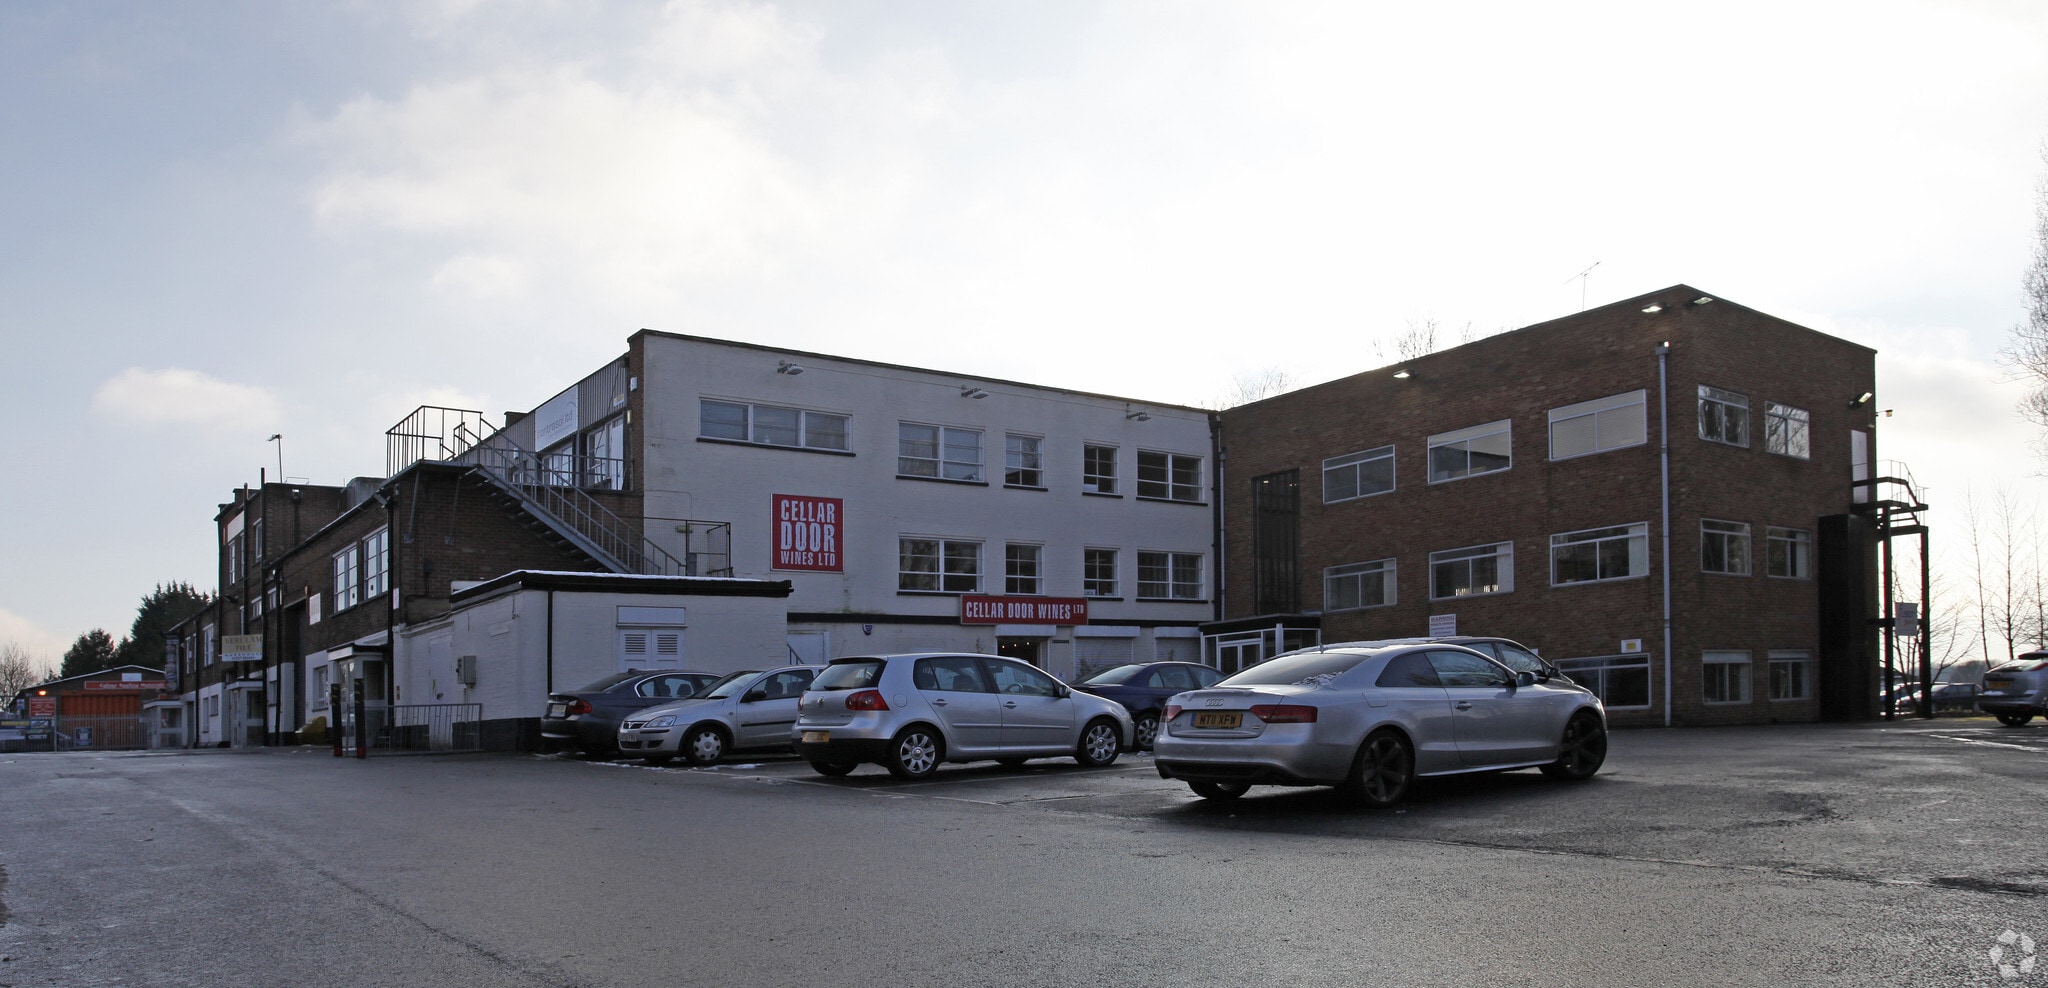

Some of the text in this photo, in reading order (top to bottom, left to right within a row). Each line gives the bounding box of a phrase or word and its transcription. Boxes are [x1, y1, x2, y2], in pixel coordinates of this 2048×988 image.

[780, 499, 835, 523] CELLAR
[780, 521, 835, 553] DOOR
[780, 551, 836, 567] WINES LTD
[966, 601, 1084, 620] CELLAR DOOR WINES LTD
[1218, 714, 1237, 725] XFW
